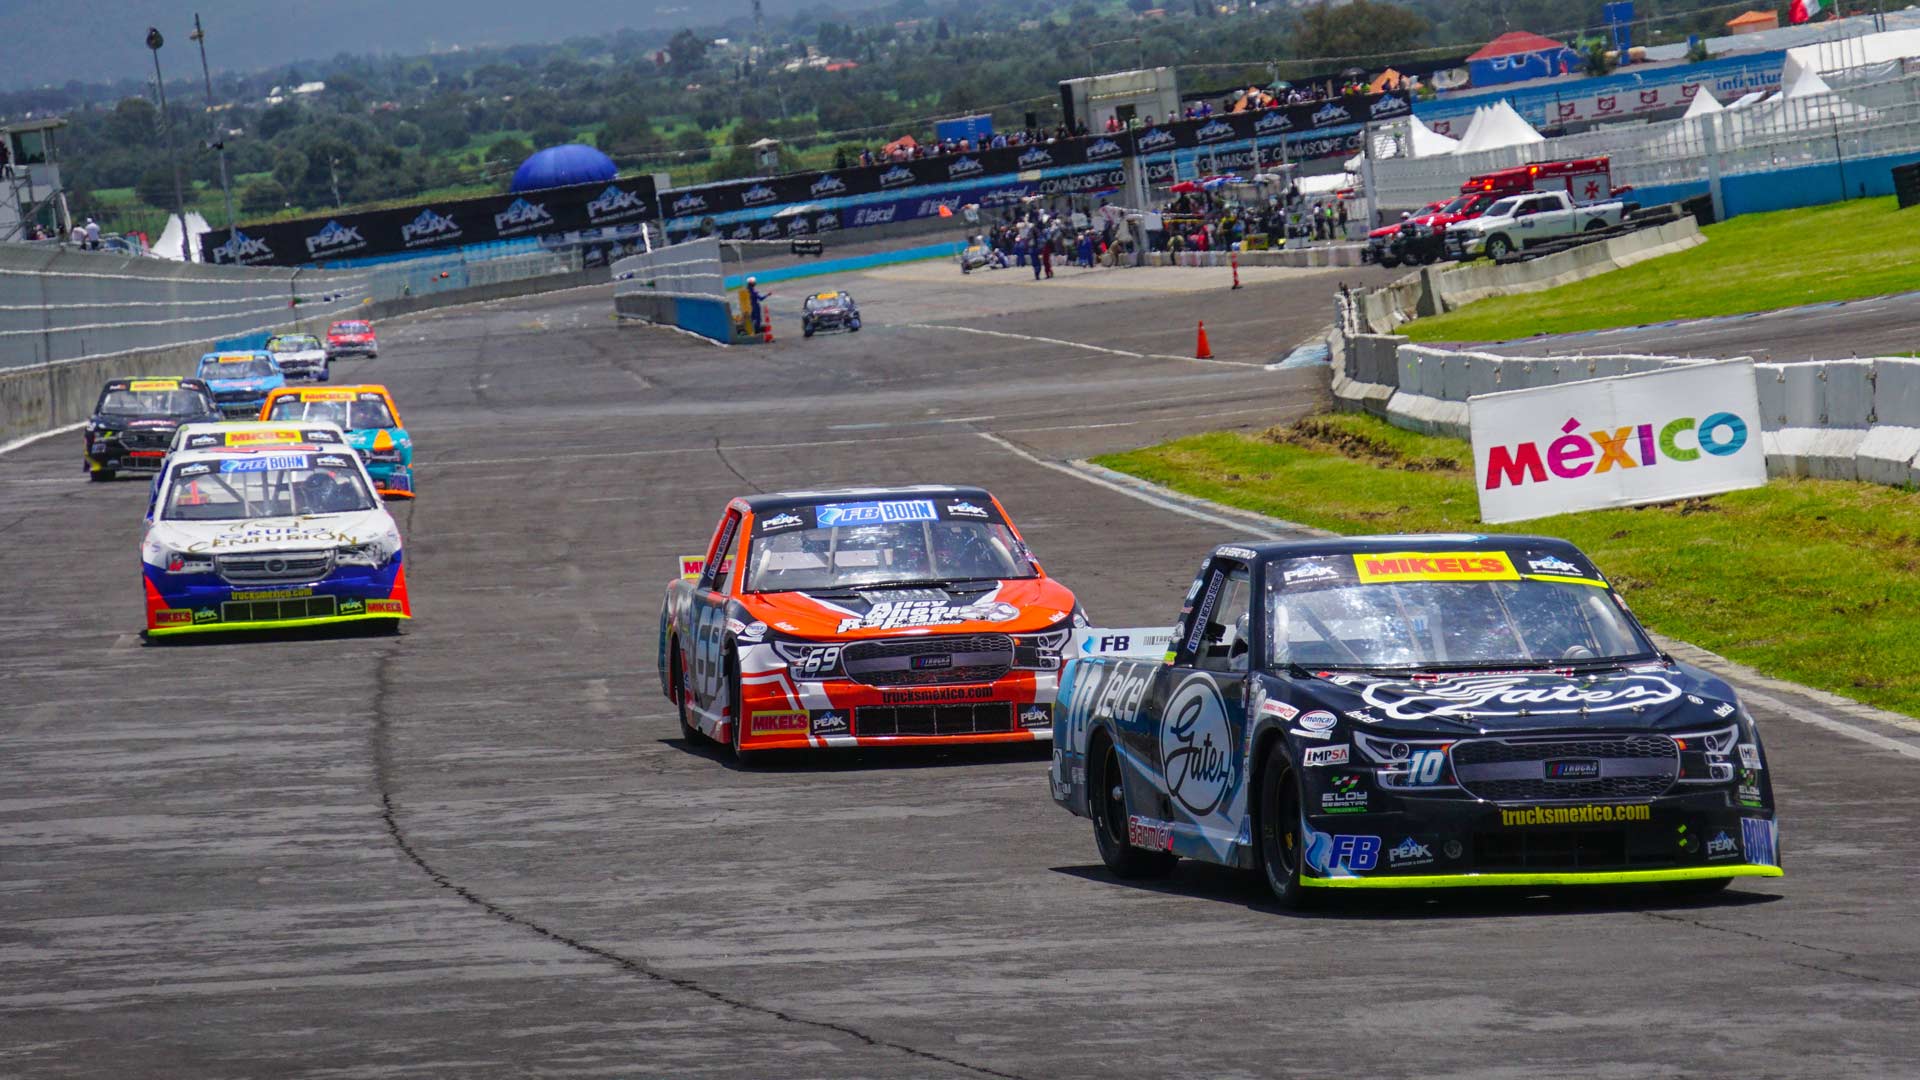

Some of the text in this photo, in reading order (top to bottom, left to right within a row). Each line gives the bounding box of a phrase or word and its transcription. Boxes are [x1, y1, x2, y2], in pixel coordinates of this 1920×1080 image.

[587, 190, 645, 217] PEAK
[494, 203, 552, 229] PEAK
[402, 213, 459, 242] PEAK
[305, 225, 364, 252] PEAK
[270, 455, 303, 469] BOHN
[842, 502, 931, 520] FB BOHN
[948, 504, 985, 515] PEAK
[762, 516, 801, 530] PEAK
[1283, 566, 1338, 581] PEAK
[1367, 558, 1505, 576] MIKEL'S
[1528, 559, 1580, 573] PEAK
[1100, 635, 1130, 652] FB
[803, 648, 840, 673] 69
[882, 685, 993, 704] trucksmexico.com
[1095, 661, 1158, 722] telcel
[752, 713, 808, 731] MIKEL'S
[813, 714, 845, 730] PEAK
[1020, 710, 1048, 724] PEAK
[1165, 695, 1229, 797] Gates
[1408, 751, 1446, 784] 10
[1502, 804, 1651, 826] trucksmexico.com
[1328, 835, 1382, 870] FB
[1389, 844, 1433, 861] PEAK
[1707, 838, 1738, 854] PEAK
